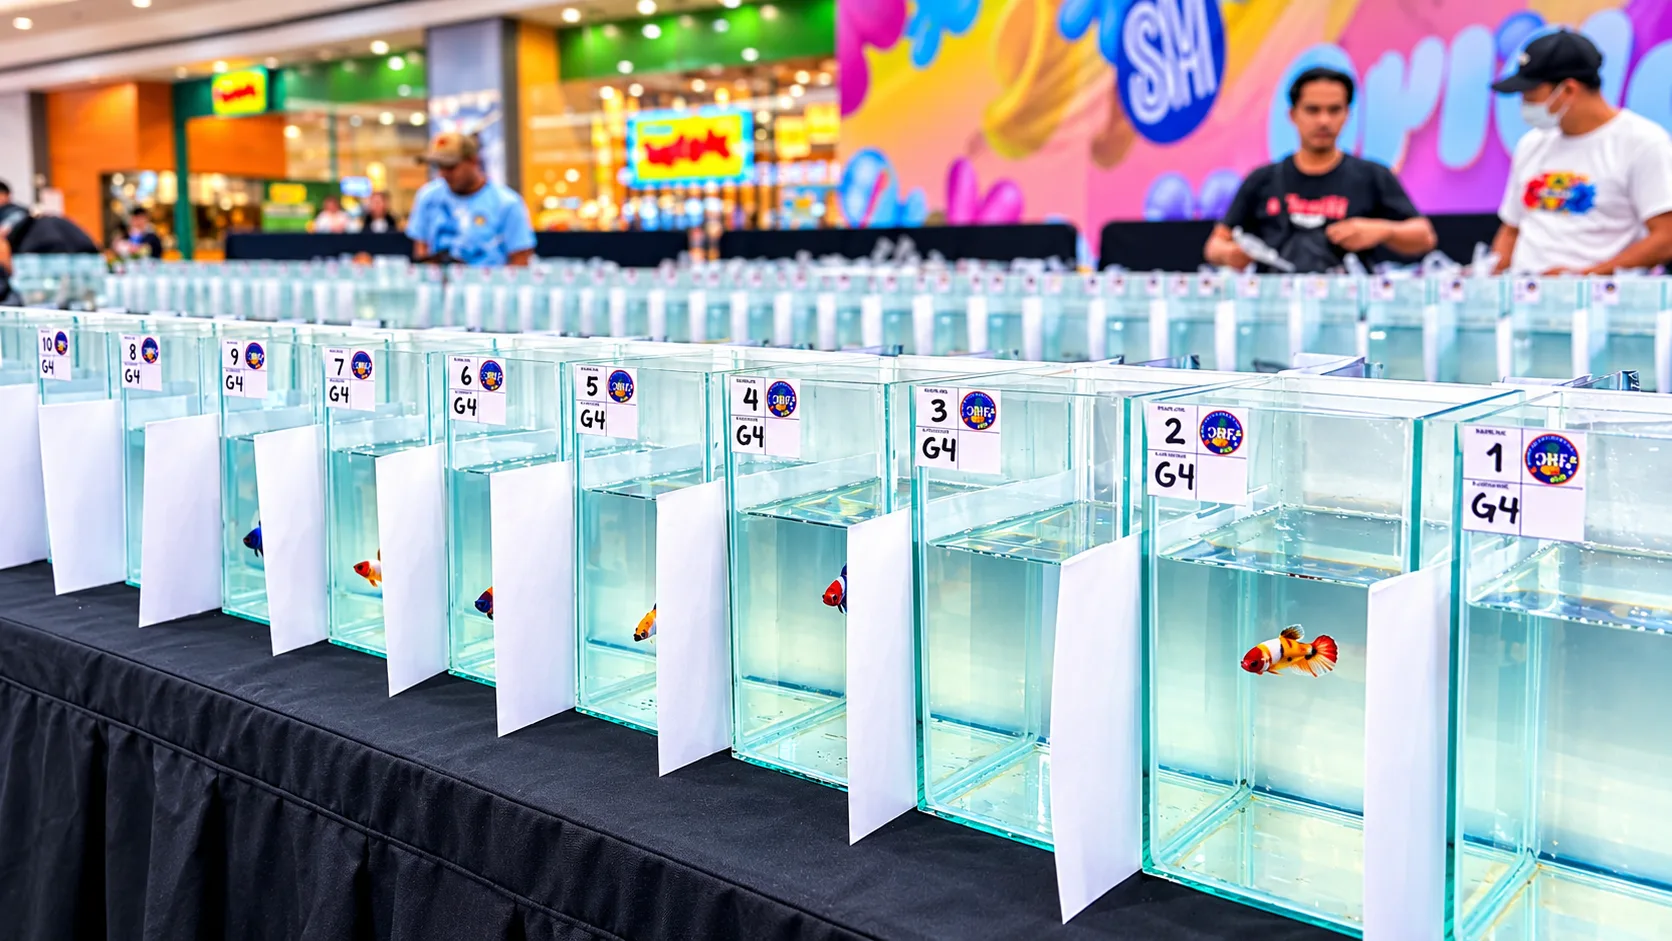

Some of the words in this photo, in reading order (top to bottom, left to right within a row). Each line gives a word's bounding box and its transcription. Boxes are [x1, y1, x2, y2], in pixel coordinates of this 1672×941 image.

[1122, 0, 1217, 125] SM
[42, 336, 53, 352] 10
[129, 343, 137, 361] 8
[41, 359, 54, 375] G4
[230, 348, 239, 366] 9
[334, 357, 345, 376] 7
[124, 368, 140, 384] G4
[225, 374, 243, 392] G4
[460, 365, 473, 386] 6
[586, 375, 599, 397] 5
[329, 384, 349, 403] G4
[743, 386, 759, 412] 4
[453, 396, 477, 416] G4
[931, 398, 948, 423] 3
[580, 408, 606, 430] G4
[736, 424, 764, 448] G4
[1164, 417, 1186, 445] 2
[922, 436, 957, 462] G4
[1486, 442, 1503, 473] 1
[1154, 460, 1195, 491] G4
[1471, 492, 1520, 525] G4
